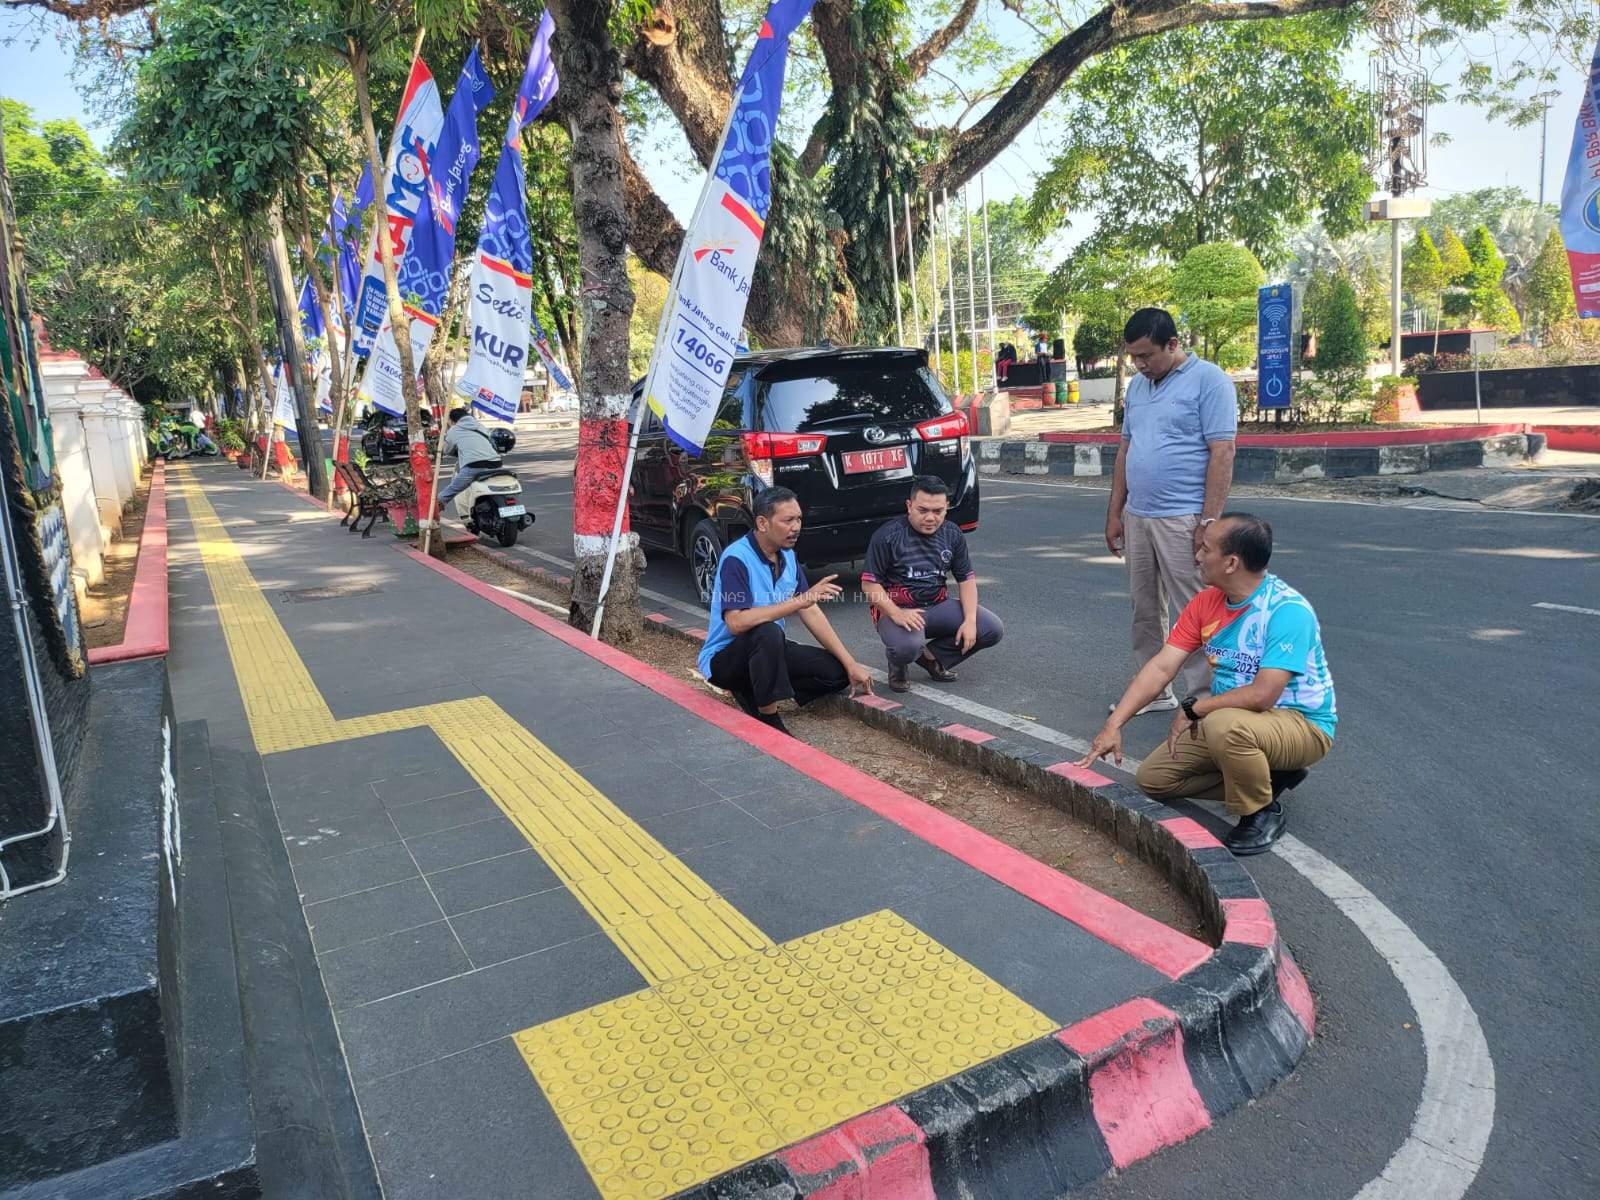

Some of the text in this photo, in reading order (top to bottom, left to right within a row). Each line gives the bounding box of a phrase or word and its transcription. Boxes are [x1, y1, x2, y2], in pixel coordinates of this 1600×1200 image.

[709, 249, 737, 284] Bank
[691, 305, 715, 330] Jateng
[715, 326, 730, 341] Call
[474, 325, 524, 368] KUR
[676, 328, 725, 374] 14066
[844, 454, 852, 467] K
[860, 451, 884, 465] 1077
[1231, 652, 1261, 665] JATENG
[1234, 661, 1259, 675] 2023
